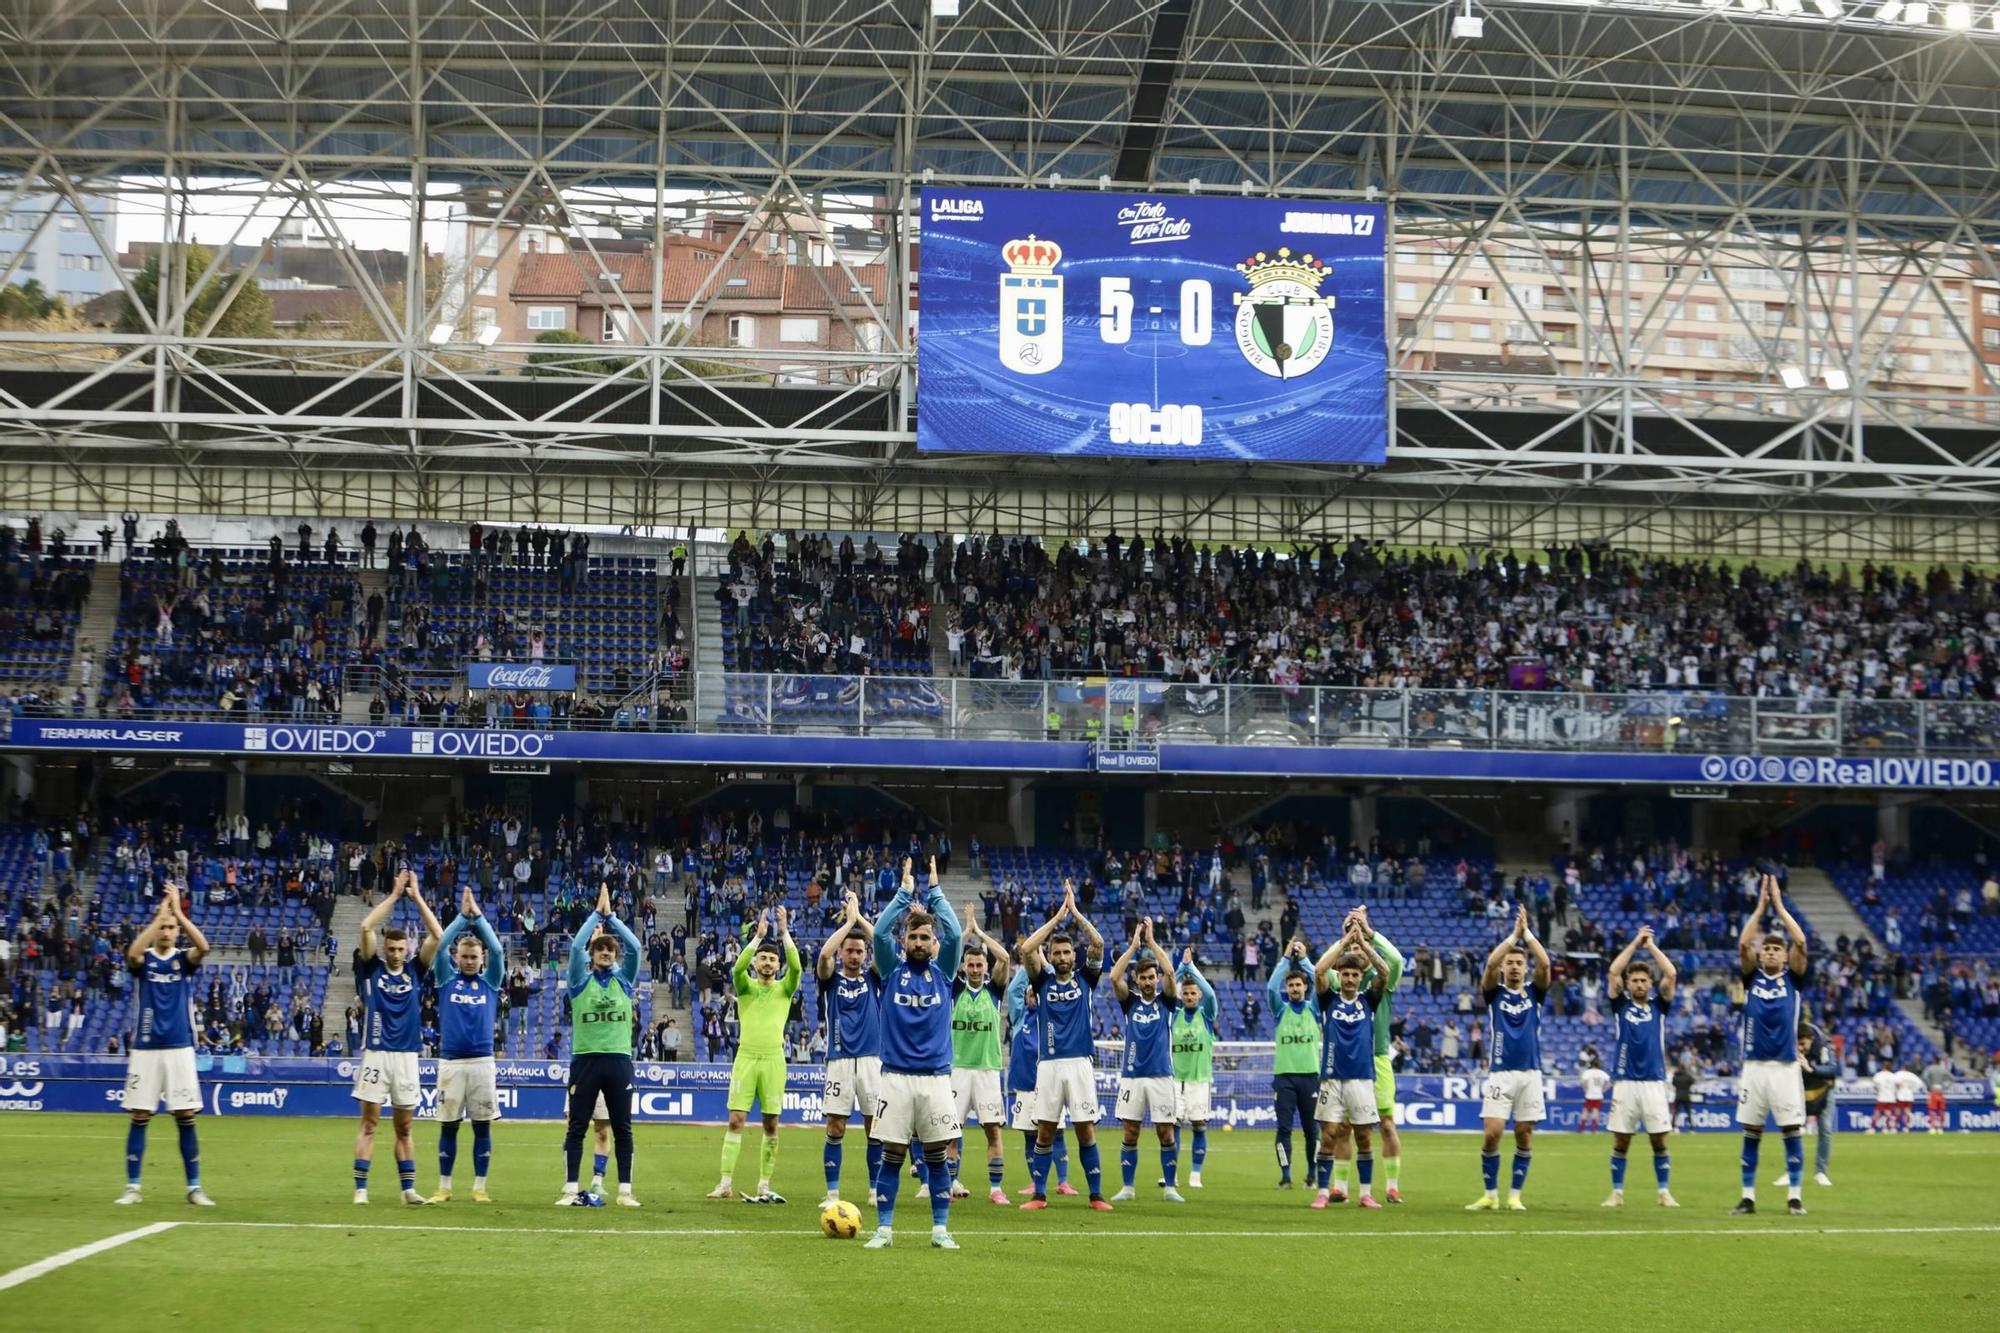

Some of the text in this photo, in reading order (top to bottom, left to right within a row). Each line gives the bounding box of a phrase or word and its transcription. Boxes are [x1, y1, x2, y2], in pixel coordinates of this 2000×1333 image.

[931, 198, 984, 214] LALIGA
[1354, 214, 1375, 236] 27
[1100, 277, 1134, 344] 5
[1180, 279, 1212, 346] 0
[1109, 402, 1203, 446] 90:00
[488, 665, 555, 688] Coca-Cola
[1126, 755, 1157, 766] OVIEDO
[894, 992, 941, 1008] DIGI
[582, 1011, 626, 1023] DIGI
[952, 1020, 992, 1032] DIGI
[363, 1066, 380, 1085] 23
[680, 1070, 707, 1080] GRUPO
[787, 1072, 809, 1080] RUPO
[825, 1080, 840, 1097] 25
[631, 1092, 693, 1116] IGI
[1395, 1102, 1456, 1127] IGI
